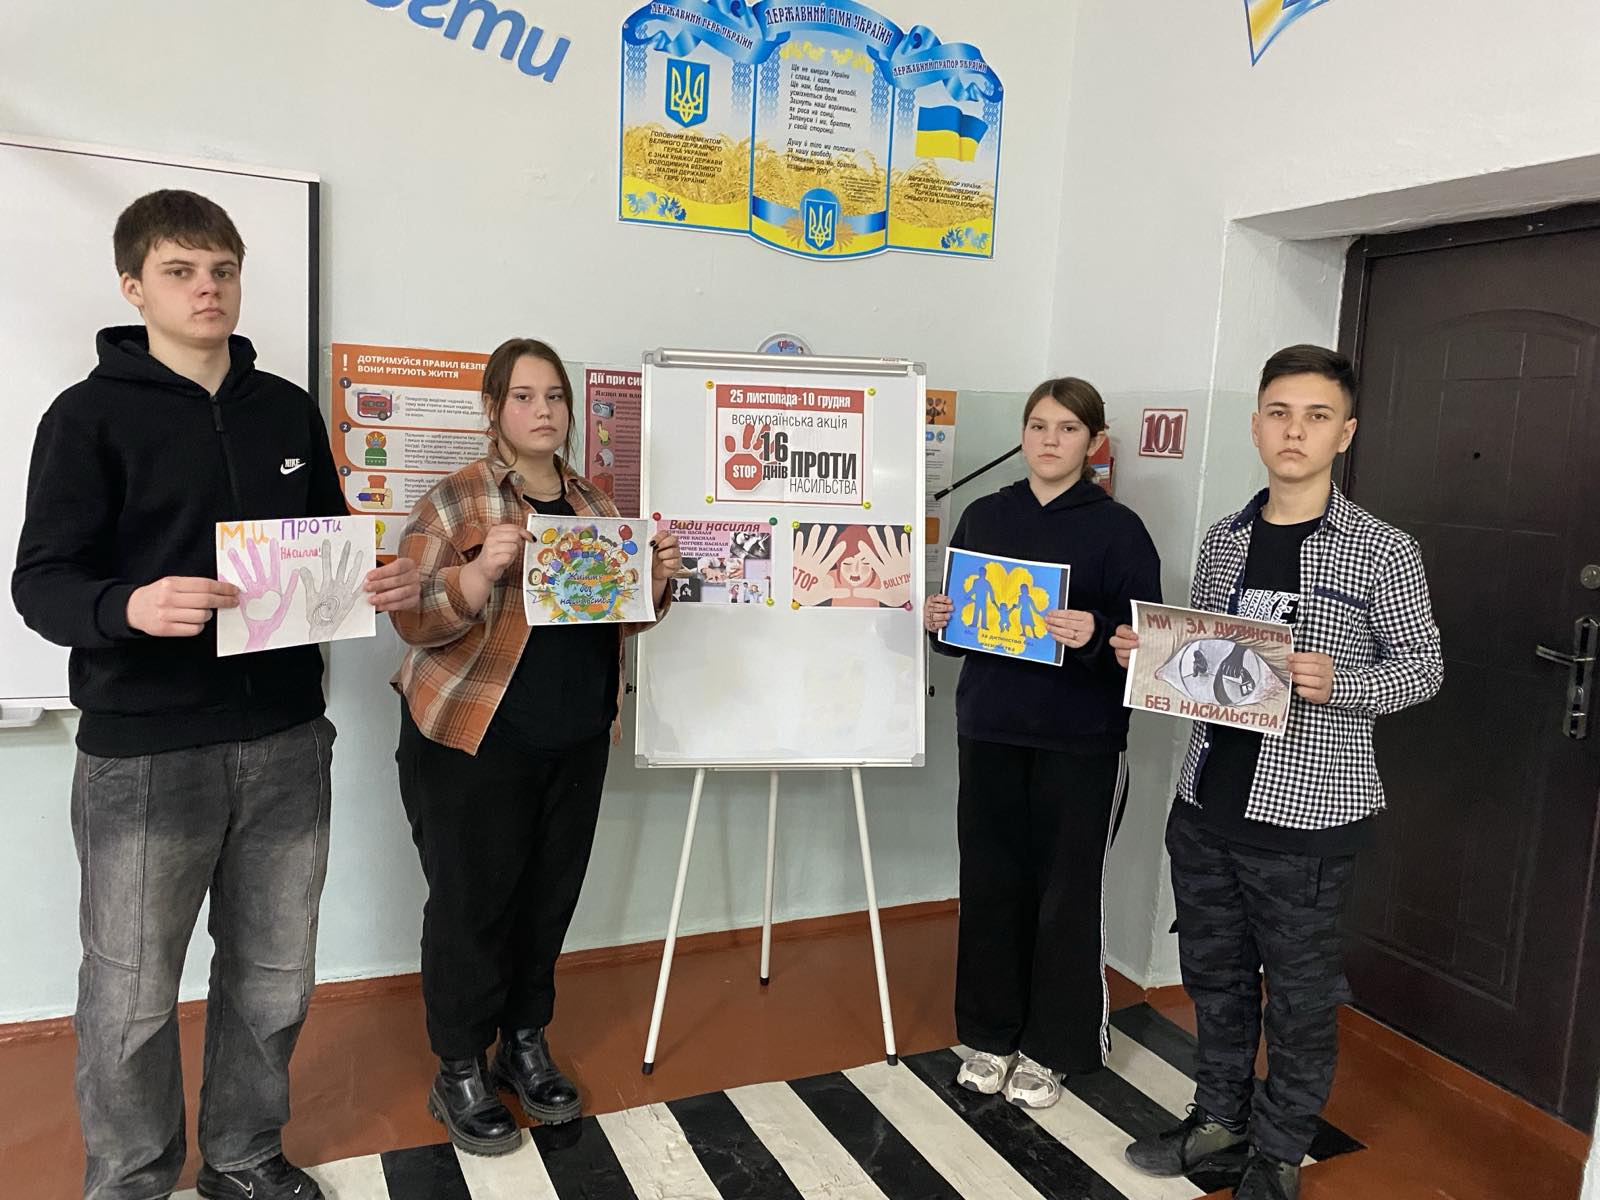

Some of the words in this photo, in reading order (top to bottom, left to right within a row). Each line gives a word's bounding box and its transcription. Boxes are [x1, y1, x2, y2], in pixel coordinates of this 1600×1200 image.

[765, 3, 826, 25] ДЕРЖАВНИЙ
[828, 11, 851, 27] ГІМН
[854, 16, 893, 45] УКРАЇНИ
[357, 355, 421, 367] ДОТРИМУЙСЯ
[422, 359, 459, 369] ПРАВИЛ
[460, 362, 487, 371] БЕЗПЕ
[357, 365, 384, 374] ВОНИ
[385, 367, 427, 377] РЯТУЮТЬ
[428, 370, 459, 379] ЖИТТЯ
[590, 373, 605, 385] Дії
[606, 375, 626, 387] при
[627, 377, 642, 387] си
[730, 389, 743, 403] 25
[818, 394, 851, 409] грудня
[732, 413, 813, 428] всеукраїнська
[817, 416, 848, 430] акція
[1142, 414, 1183, 454] 101
[761, 431, 789, 463] 16
[733, 465, 757, 478] STOP
[790, 451, 857, 480] ПРОТИ
[789, 478, 858, 495] НАСИЛЬСТВА
[669, 520, 702, 531] Види
[706, 522, 760, 533] насилля
[1146, 613, 1172, 630] МИ
[1186, 617, 1207, 634] ЗА
[1213, 620, 1292, 645] ДИТИНСТВО
[1145, 694, 1171, 712] БЕЗ
